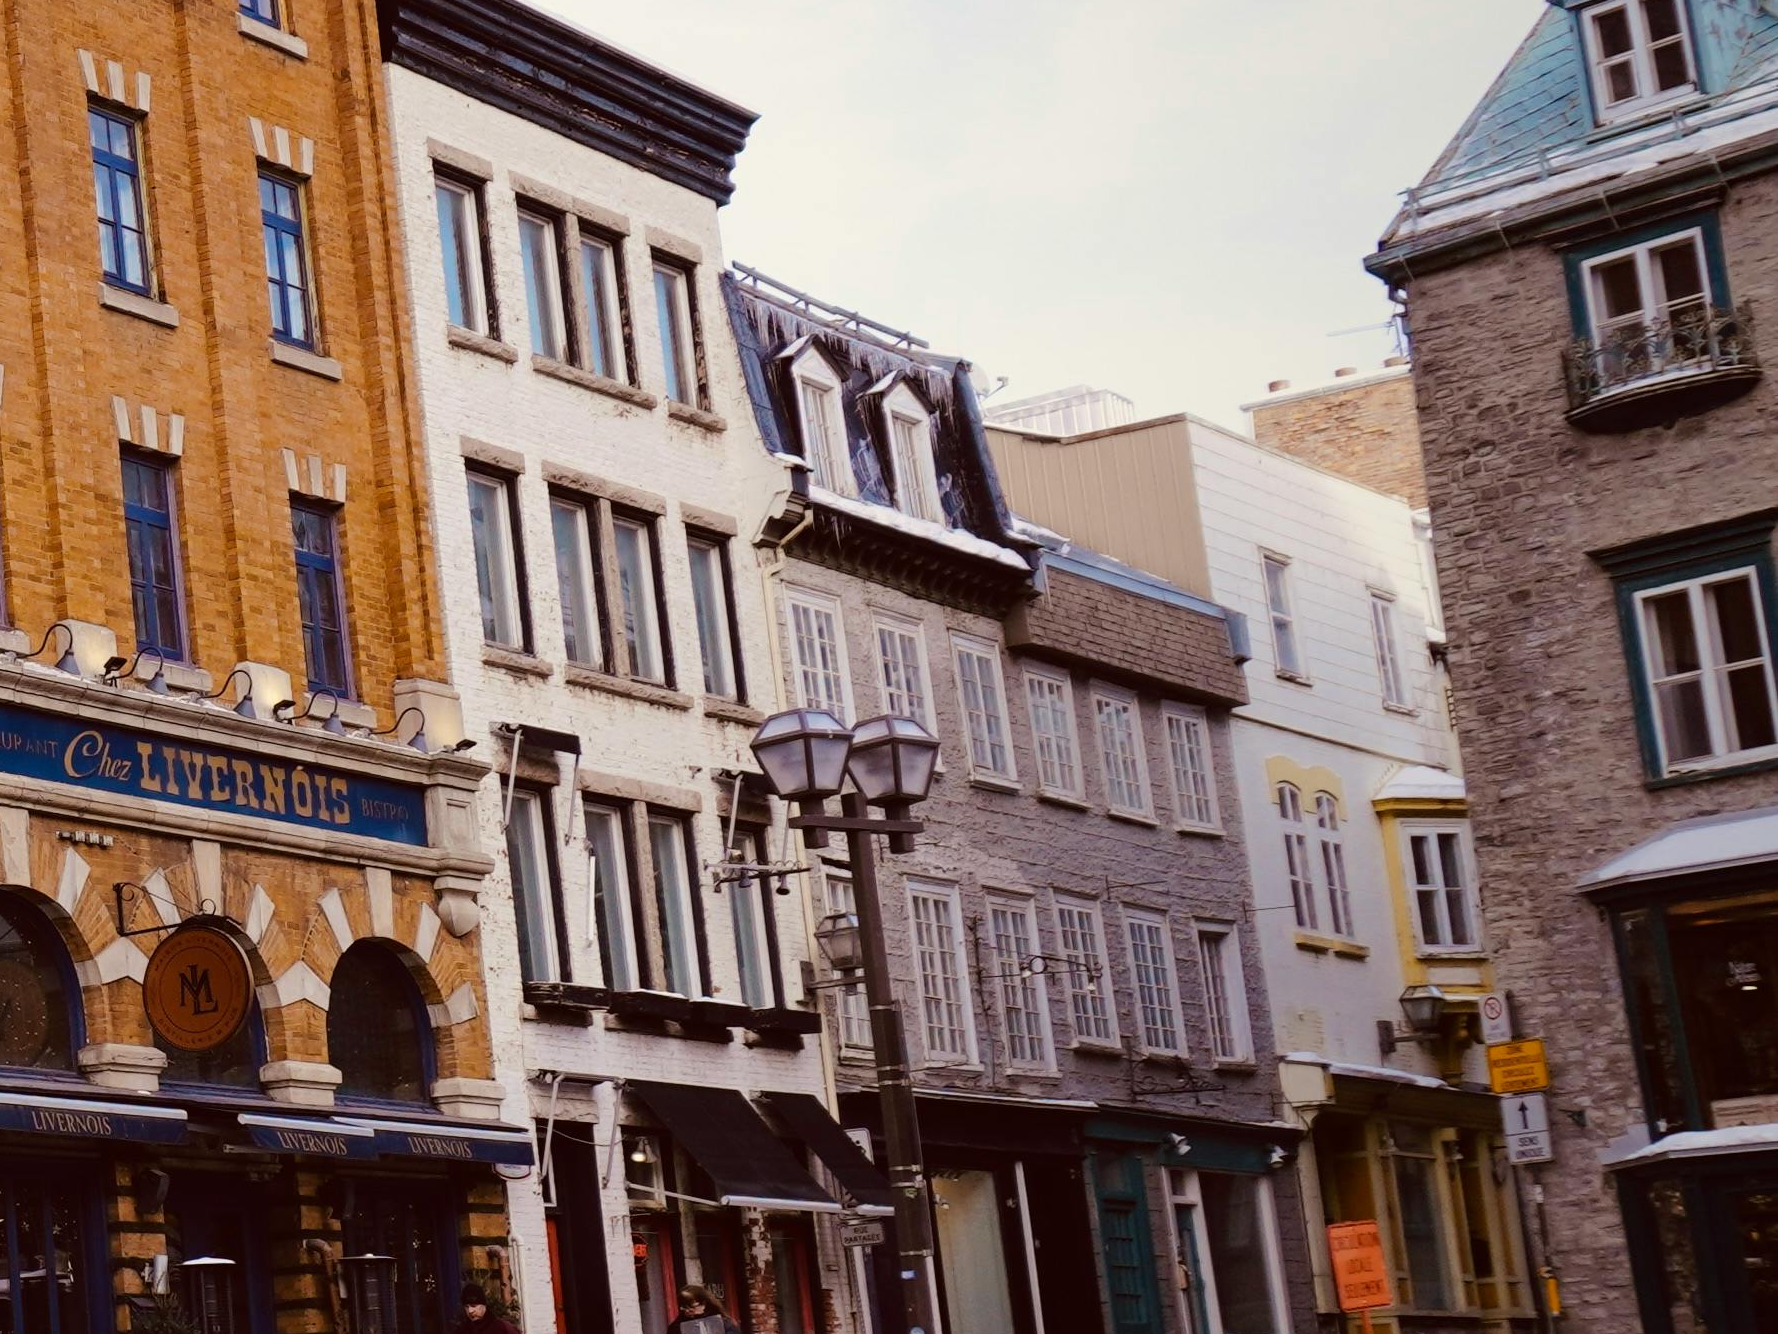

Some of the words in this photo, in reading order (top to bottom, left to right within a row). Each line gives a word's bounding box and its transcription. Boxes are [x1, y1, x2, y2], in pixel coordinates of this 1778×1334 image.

[63, 729, 133, 782] Chez
[359, 798, 410, 821] BISTRO
[31, 1110, 112, 1136] LIVERNOIS
[277, 1131, 348, 1156] LIVERNOIS
[408, 1136, 473, 1159] LIVERNOIS
